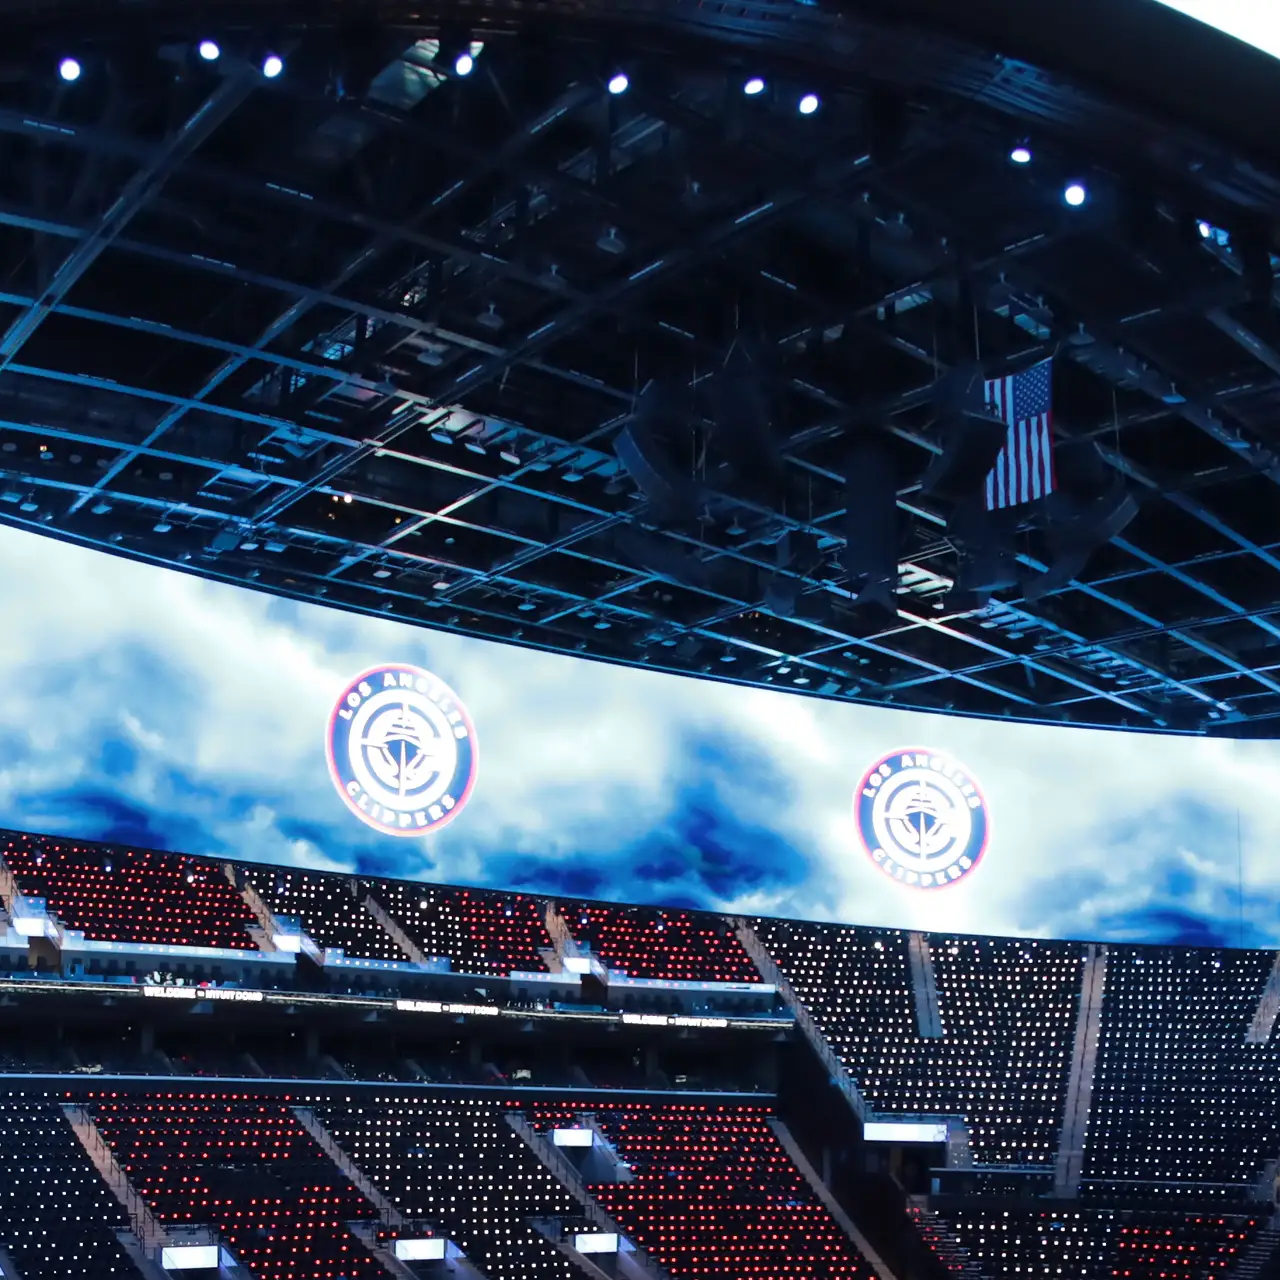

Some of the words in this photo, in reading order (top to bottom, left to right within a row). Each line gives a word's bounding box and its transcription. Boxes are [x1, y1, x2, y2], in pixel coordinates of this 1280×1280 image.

[339, 681, 372, 721] LOS
[863, 763, 892, 798] LOS
[347, 780, 456, 828] CLIPPERS
